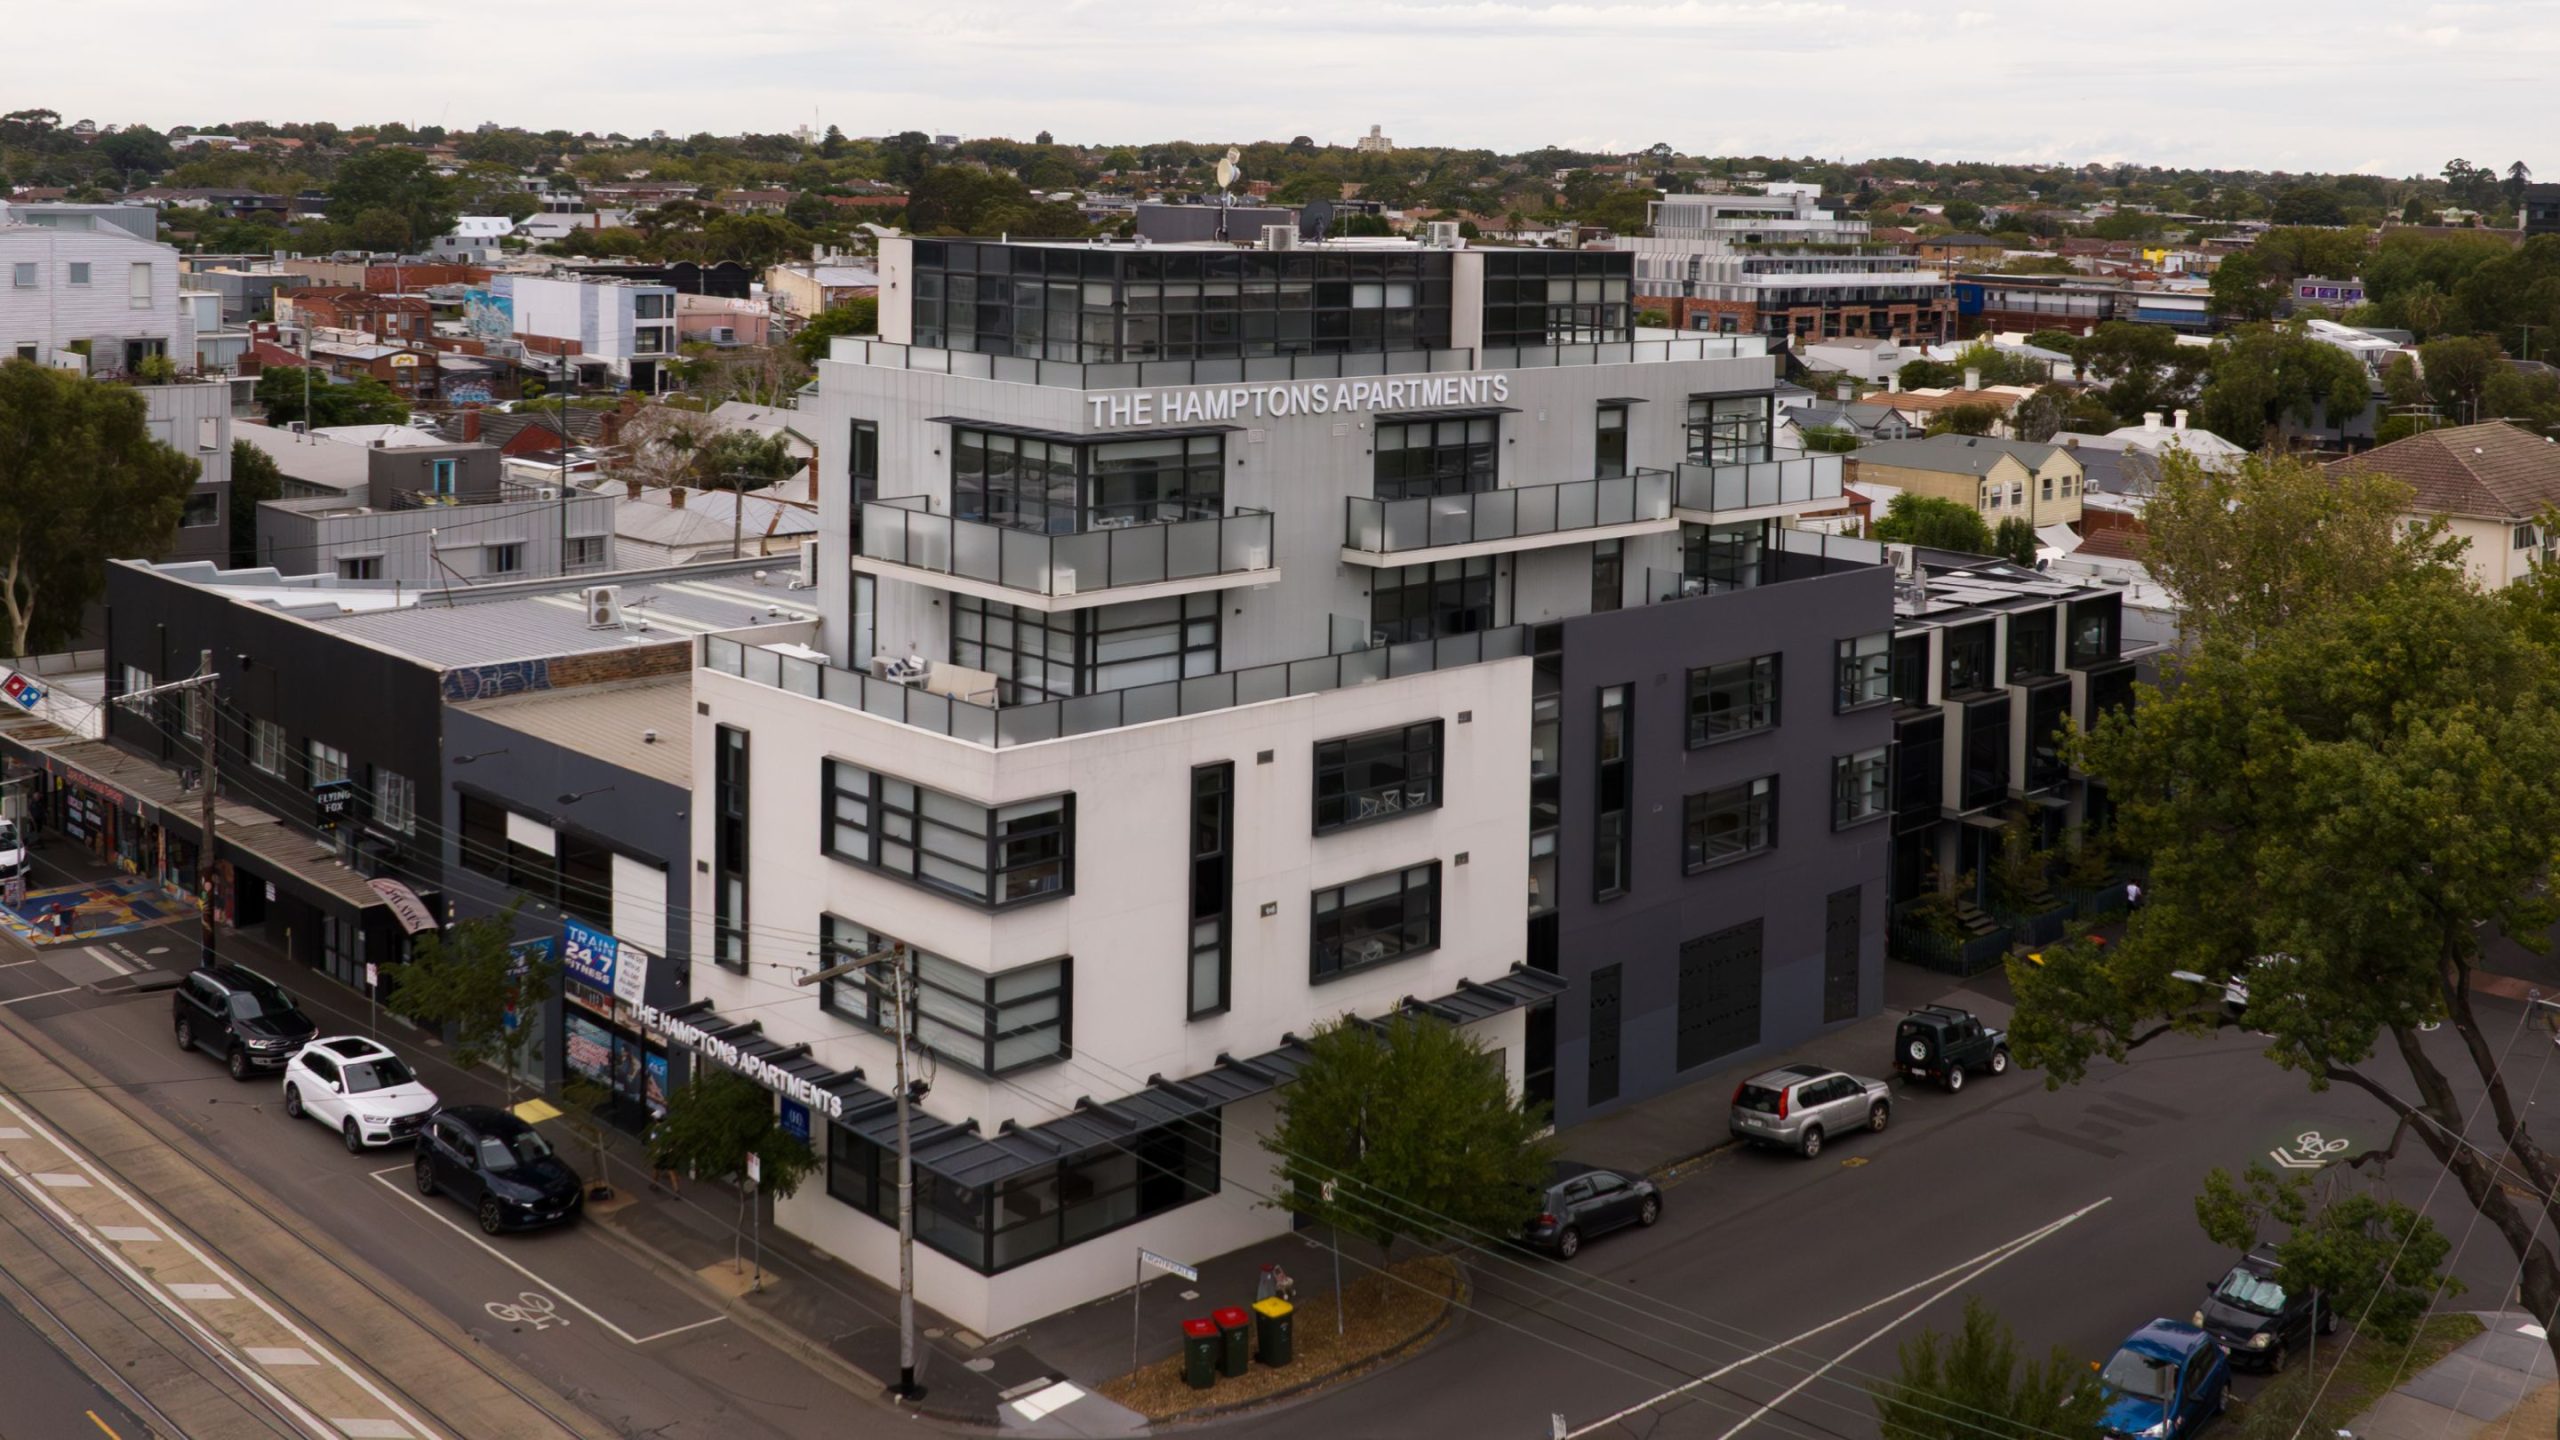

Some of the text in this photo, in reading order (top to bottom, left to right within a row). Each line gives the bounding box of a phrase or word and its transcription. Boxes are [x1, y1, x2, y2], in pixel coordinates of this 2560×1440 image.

[1088, 374, 1508, 427] THE HAMPTONS APARTMENTS
[318, 790, 351, 804] FLYING
[325, 802, 344, 813] FOX
[565, 940, 612, 973] 24/7
[568, 925, 615, 957] TRAIN
[564, 957, 610, 985] FITNESS
[630, 999, 659, 1028] THE
[659, 1012, 738, 1066] HAMPTONS
[739, 1052, 842, 1118] APARTMENTS
